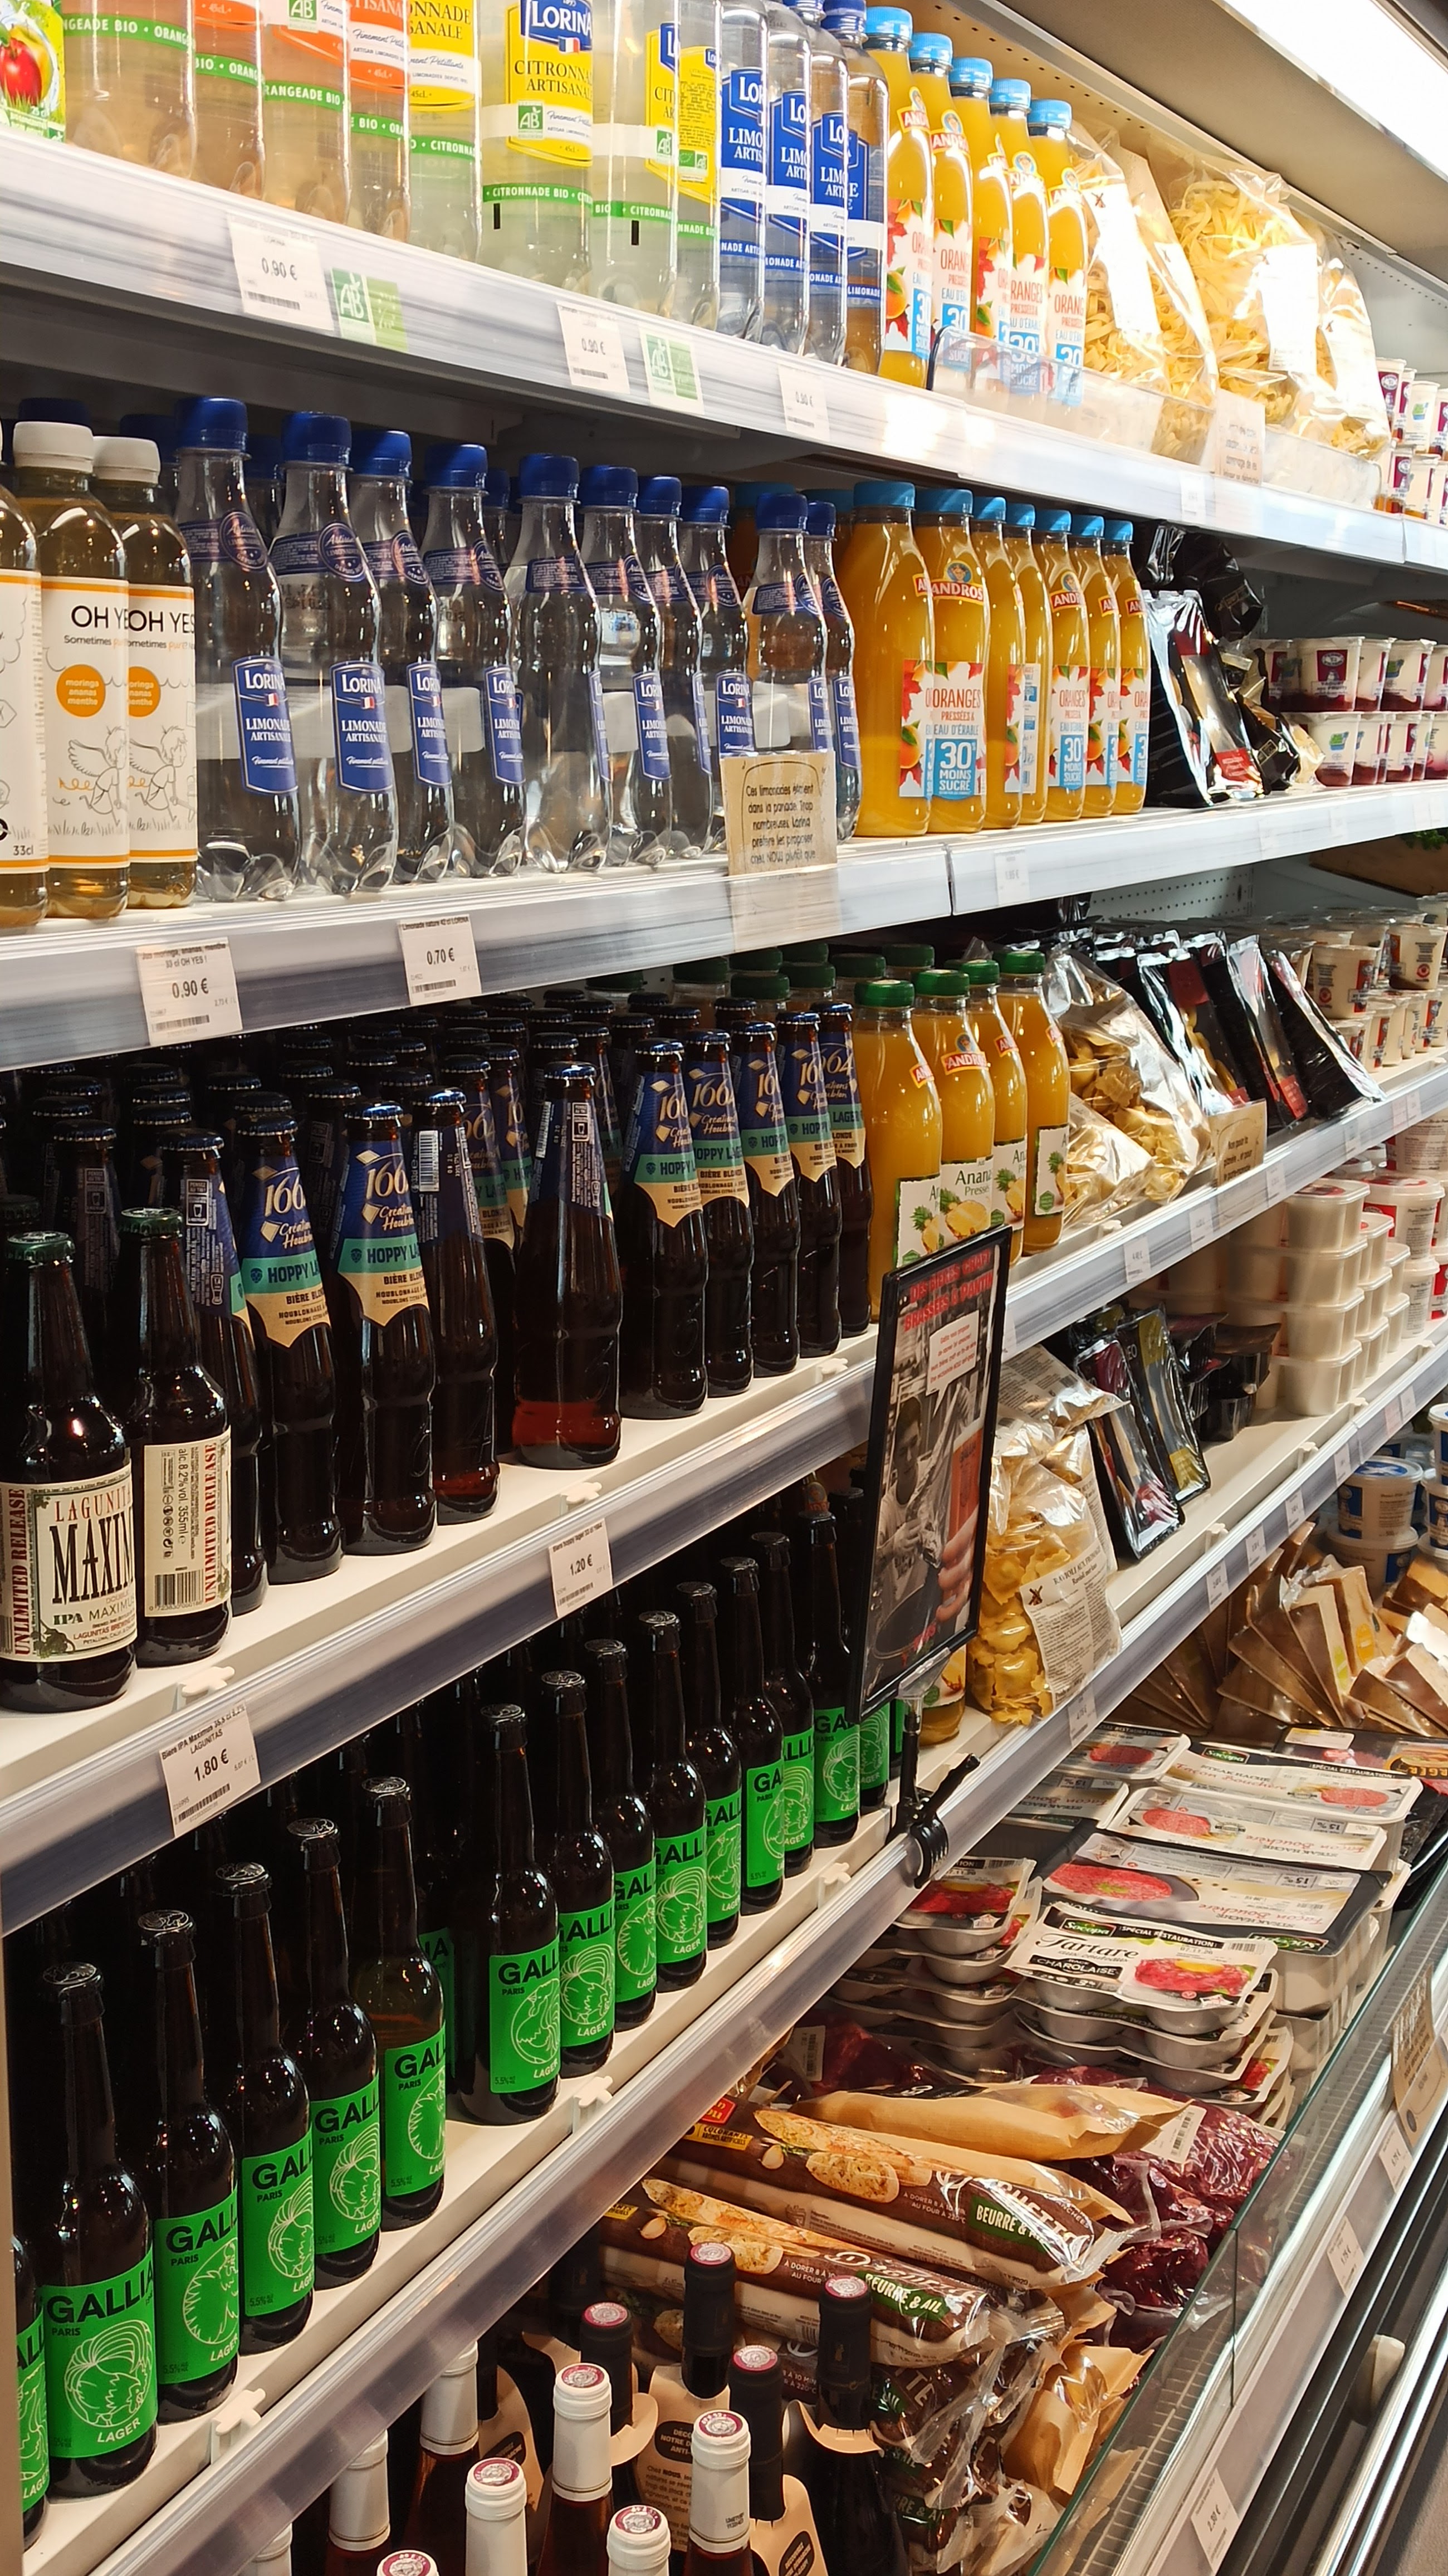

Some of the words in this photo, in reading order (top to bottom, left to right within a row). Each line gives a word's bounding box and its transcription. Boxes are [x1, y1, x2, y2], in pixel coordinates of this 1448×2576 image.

[290, 2, 314, 19] AB
[115, 20, 138, 33] BIO
[531, 3, 593, 39] LORINA
[326, 92, 340, 106] BIO
[359, 117, 378, 129] BIO
[520, 106, 541, 129] AB
[492, 187, 550, 197] CITRONNADE
[553, 188, 569, 199] BIO
[595, 204, 612, 215] BIO
[289, 264, 298, 281] €
[932, 583, 984, 602] ANDROS
[71, 605, 109, 628] OH
[129, 609, 164, 632] OH
[170, 612, 195, 635] YES
[64, 635, 112, 645] Sometimes
[128, 640, 167, 649] ometimes
[65, 679, 99, 688] moringa
[245, 670, 286, 691] LORINA
[341, 672, 383, 695] LORINA
[67, 697, 98, 706] menthe
[932, 688, 981, 708] ORANGES
[341, 719, 387, 733] LIMONADE
[934, 724, 949, 735] EAU
[939, 770, 972, 780] MOINS
[13, 845, 34, 856] 33cl
[180, 958, 190, 967] OH
[192, 955, 204, 965] YES
[427, 948, 447, 965] 0.70
[448, 947, 455, 962] €
[172, 979, 198, 999] 0.90
[200, 978, 209, 995] €
[366, 1246, 408, 1265] HOPPY
[267, 1265, 309, 1284] HOPPY
[383, 1272, 408, 1285] BIÈRE
[286, 1291, 310, 1305] BIÈRE
[204, 1442, 217, 1512] RELEASE
[8, 1489, 28, 1561] RELEASE
[178, 1505, 189, 1535] 355ml
[204, 1516, 217, 1603] UNLIMITED
[570, 1558, 586, 1576] 1.20
[587, 1553, 593, 1567] €
[12, 1564, 31, 1655] UNLIMITED
[53, 1613, 84, 1626] IPA
[89, 1597, 135, 1622] MAXIMUS
[73, 1627, 110, 1640] LAGUNITAS
[178, 1740, 188, 1751] IPA
[188, 1725, 214, 1744] Maximus
[190, 1729, 223, 1754] LAGUNITAS
[194, 1755, 219, 1782] 1.80
[221, 1748, 229, 1764] €
[1064, 1921, 1111, 1937] Socopa
[1122, 1925, 1153, 1937] SPÉCIAL
[1154, 1930, 1215, 1948] RESTAURATION
[674, 1938, 701, 1955] LAGER
[1035, 1933, 1139, 1960] Tartare
[1036, 1957, 1118, 1975] CHAROLAISE
[502, 1985, 526, 1996] PARIS
[577, 2020, 608, 2037] LAGER
[533, 2059, 559, 2079] LAGER
[398, 2078, 422, 2091] PARIS
[319, 2134, 345, 2146] PARIS
[256, 2189, 283, 2203] PARIS
[909, 2193, 932, 2204] DORER
[922, 2204, 940, 2214] FOUR
[976, 2204, 1015, 2232] BEURRE
[1018, 2225, 1027, 2236] &
[171, 2252, 200, 2267] PARIS
[791, 2262, 814, 2273] DORER
[803, 2273, 822, 2285] FOUR
[47, 2267, 154, 2325] GALLIA
[865, 2274, 912, 2305] BEURRE
[909, 2297, 920, 2309] &
[921, 2296, 942, 2314] AIL
[51, 2325, 81, 2338] PARIS
[97, 2416, 142, 2446] LAGER
[660, 2434, 684, 2446] NOTRE
